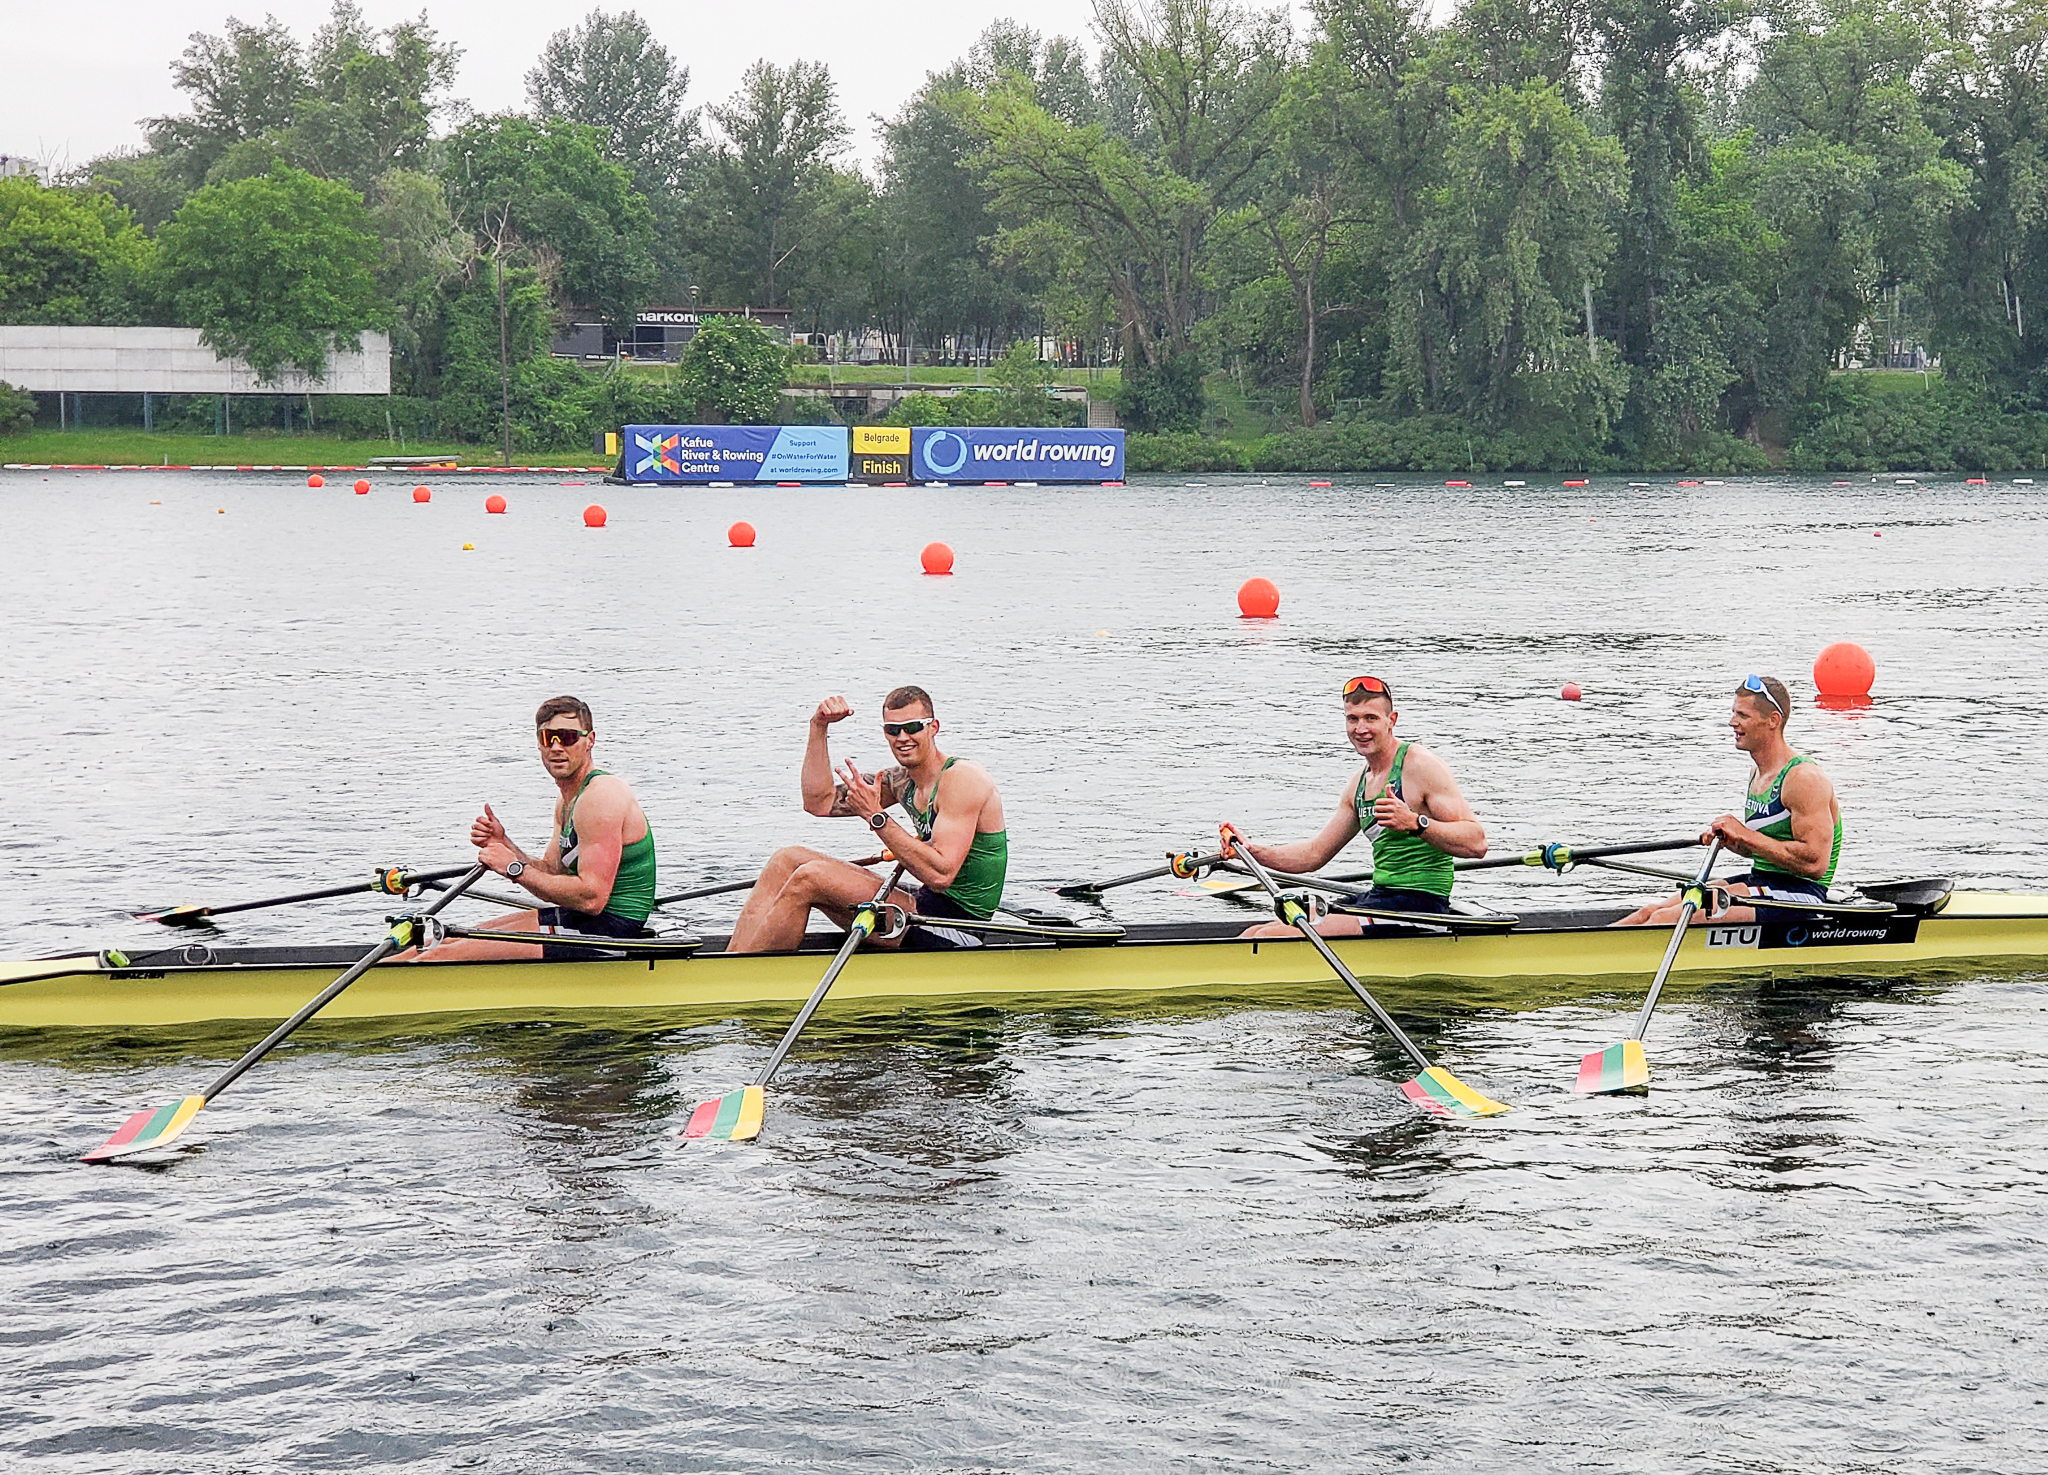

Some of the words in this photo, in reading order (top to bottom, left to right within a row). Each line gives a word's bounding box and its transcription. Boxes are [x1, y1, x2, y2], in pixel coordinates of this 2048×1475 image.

[681, 436, 714, 448] Kafue
[789, 439, 817, 447] Support
[864, 432, 900, 444] Belgrade
[681, 449, 710, 460] River
[711, 449, 722, 460] &
[722, 449, 764, 463] Rowing
[973, 438, 1039, 461] world
[1040, 444, 1116, 467] rowing
[681, 462, 720, 473] Centre
[778, 466, 839, 474] worldrowing.com
[862, 460, 901, 474] Finish
[1745, 799, 1770, 816] ETUVA
[1709, 928, 1758, 946] LTU
[1811, 928, 1845, 940] world
[1846, 928, 1888, 939] rowing
